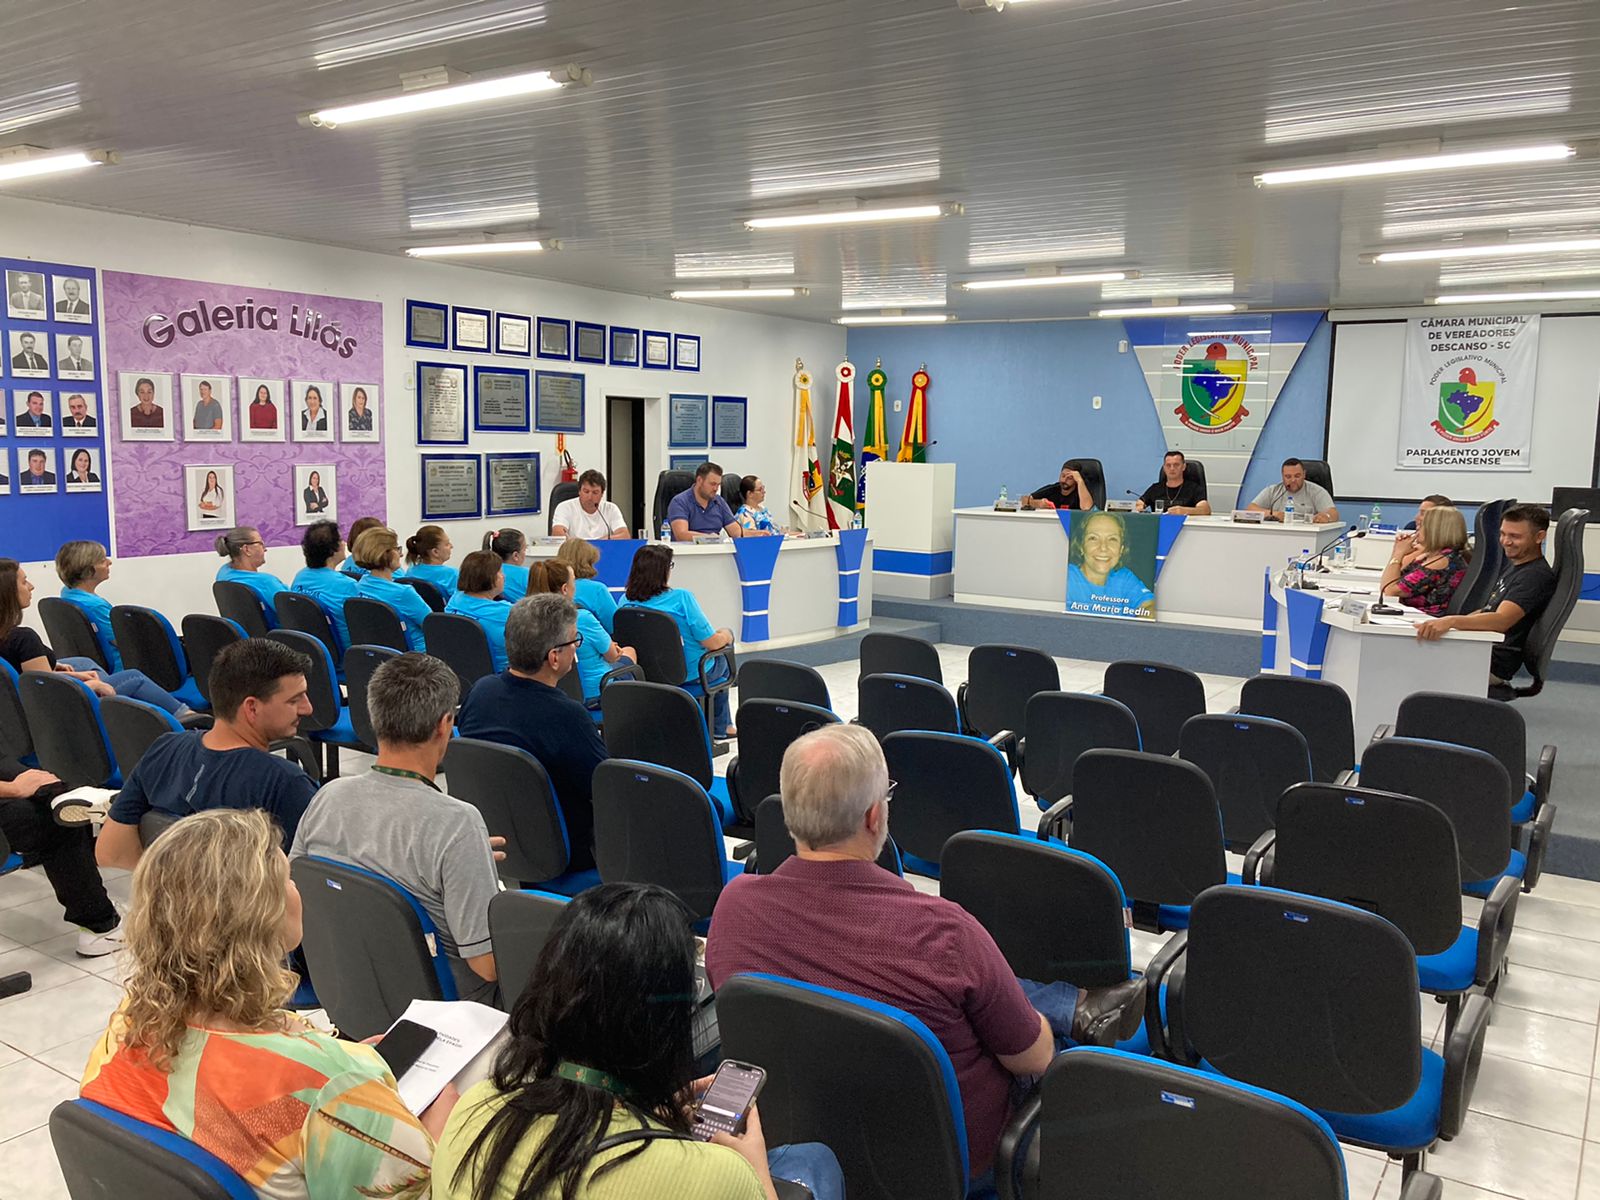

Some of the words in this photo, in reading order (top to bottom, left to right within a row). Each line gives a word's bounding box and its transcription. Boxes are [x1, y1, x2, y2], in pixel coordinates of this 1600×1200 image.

[142, 297, 279, 349] Galeria
[289, 304, 358, 359] Lilás
[1421, 317, 1466, 328] CÂMARA
[1468, 316, 1526, 326] MUNICIPAL
[1428, 332, 1442, 340] DE
[1445, 328, 1516, 339] VEREADORES
[1431, 342, 1487, 352] DESCANSO
[1497, 341, 1511, 349] SC
[1430, 367, 1444, 386] PODER
[1444, 354, 1483, 368] LEGISLATIVO
[1484, 358, 1507, 384] MUNICIPAL
[1423, 457, 1501, 465] DESCANSENSE
[1091, 594, 1129, 603] Professora
[1070, 601, 1089, 611] Ana
[1092, 603, 1120, 614] Maria
[1123, 606, 1150, 616] Bedin
